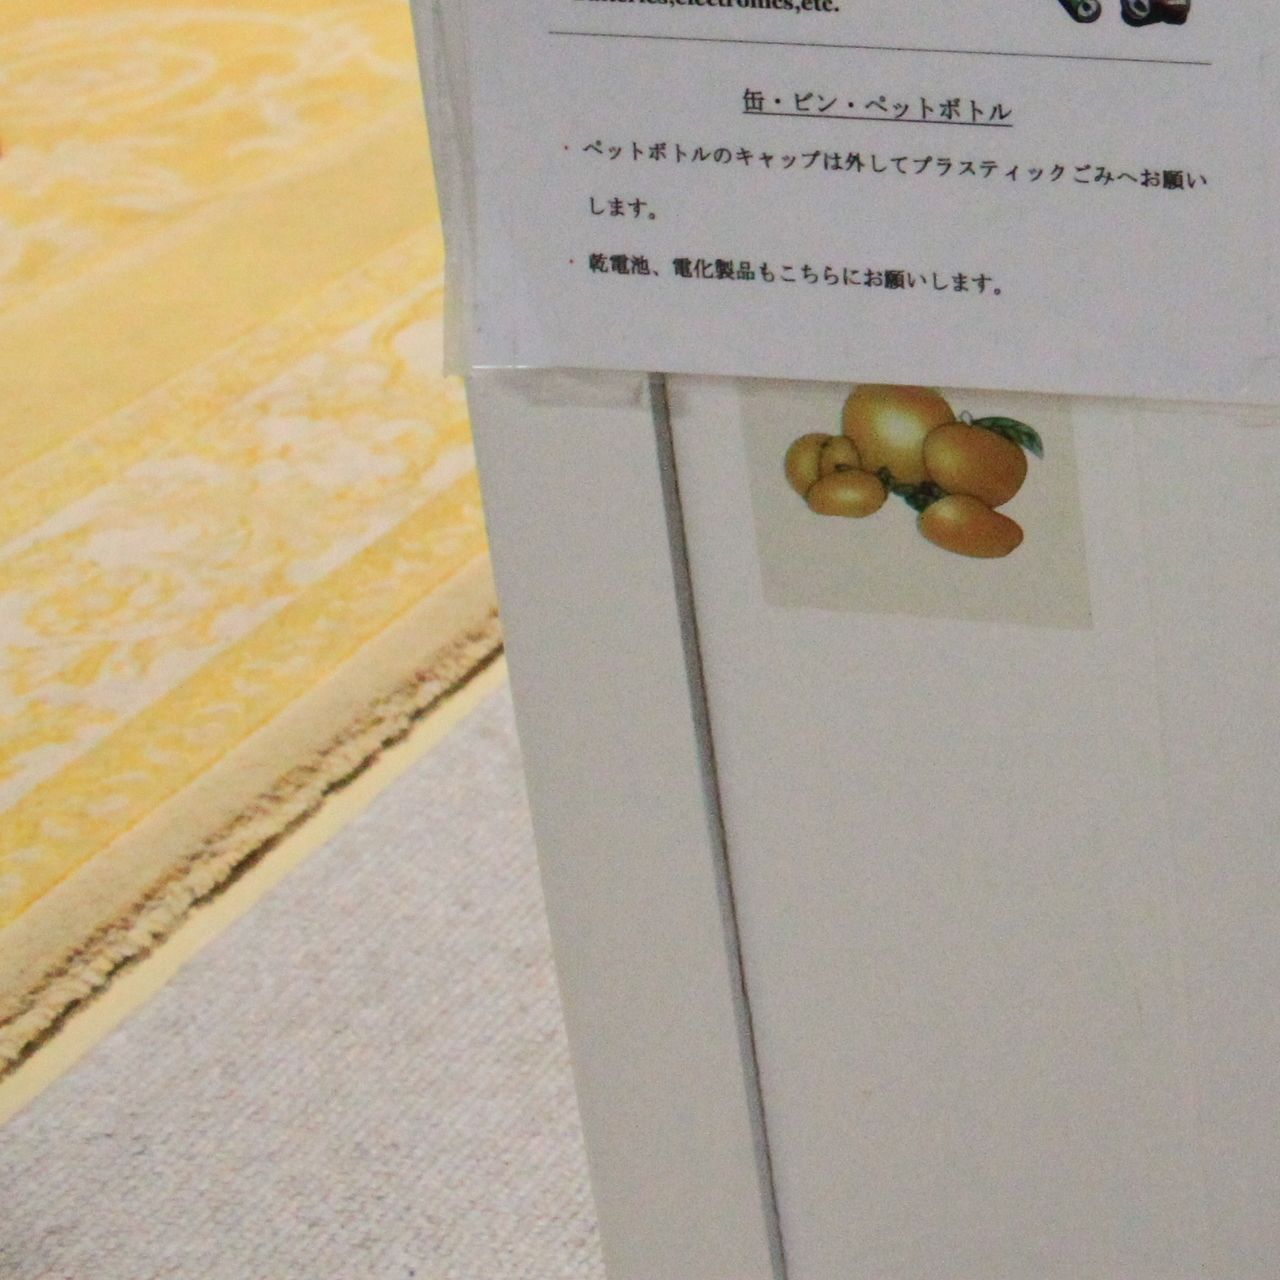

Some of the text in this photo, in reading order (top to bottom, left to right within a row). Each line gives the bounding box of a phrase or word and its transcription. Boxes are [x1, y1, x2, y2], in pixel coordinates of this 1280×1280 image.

[582, 139, 1208, 192] ペットボトルのキャップは外してプラスティックごみへお願い
[589, 196, 657, 221] します。
